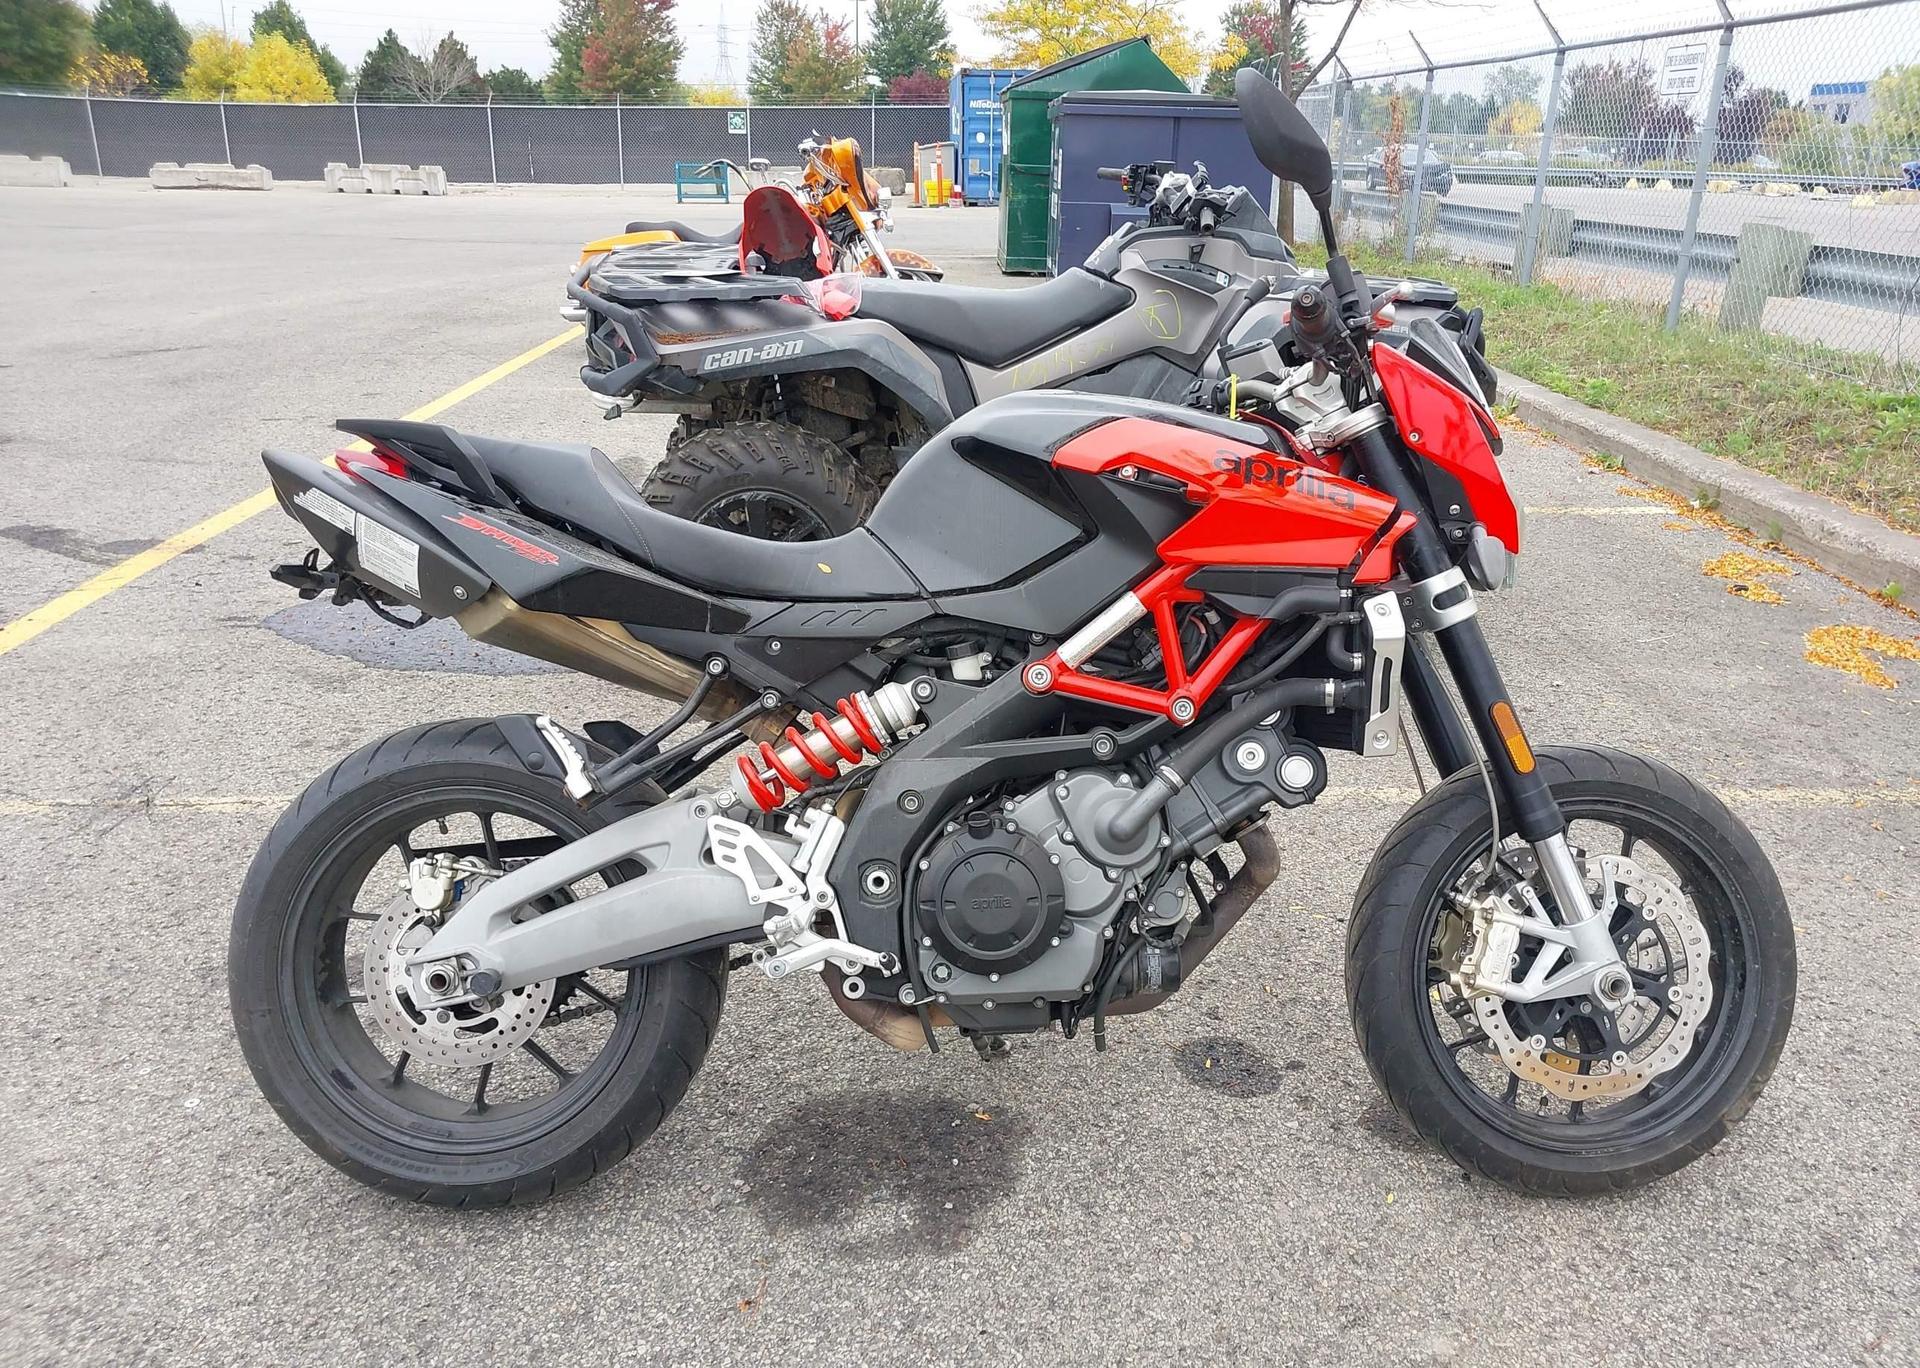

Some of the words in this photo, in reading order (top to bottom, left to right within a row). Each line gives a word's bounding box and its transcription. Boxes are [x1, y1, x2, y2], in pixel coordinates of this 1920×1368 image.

[703, 339, 804, 370] can-am
[1213, 449, 1356, 511] aprilia
[971, 894, 1012, 912] aprilia
